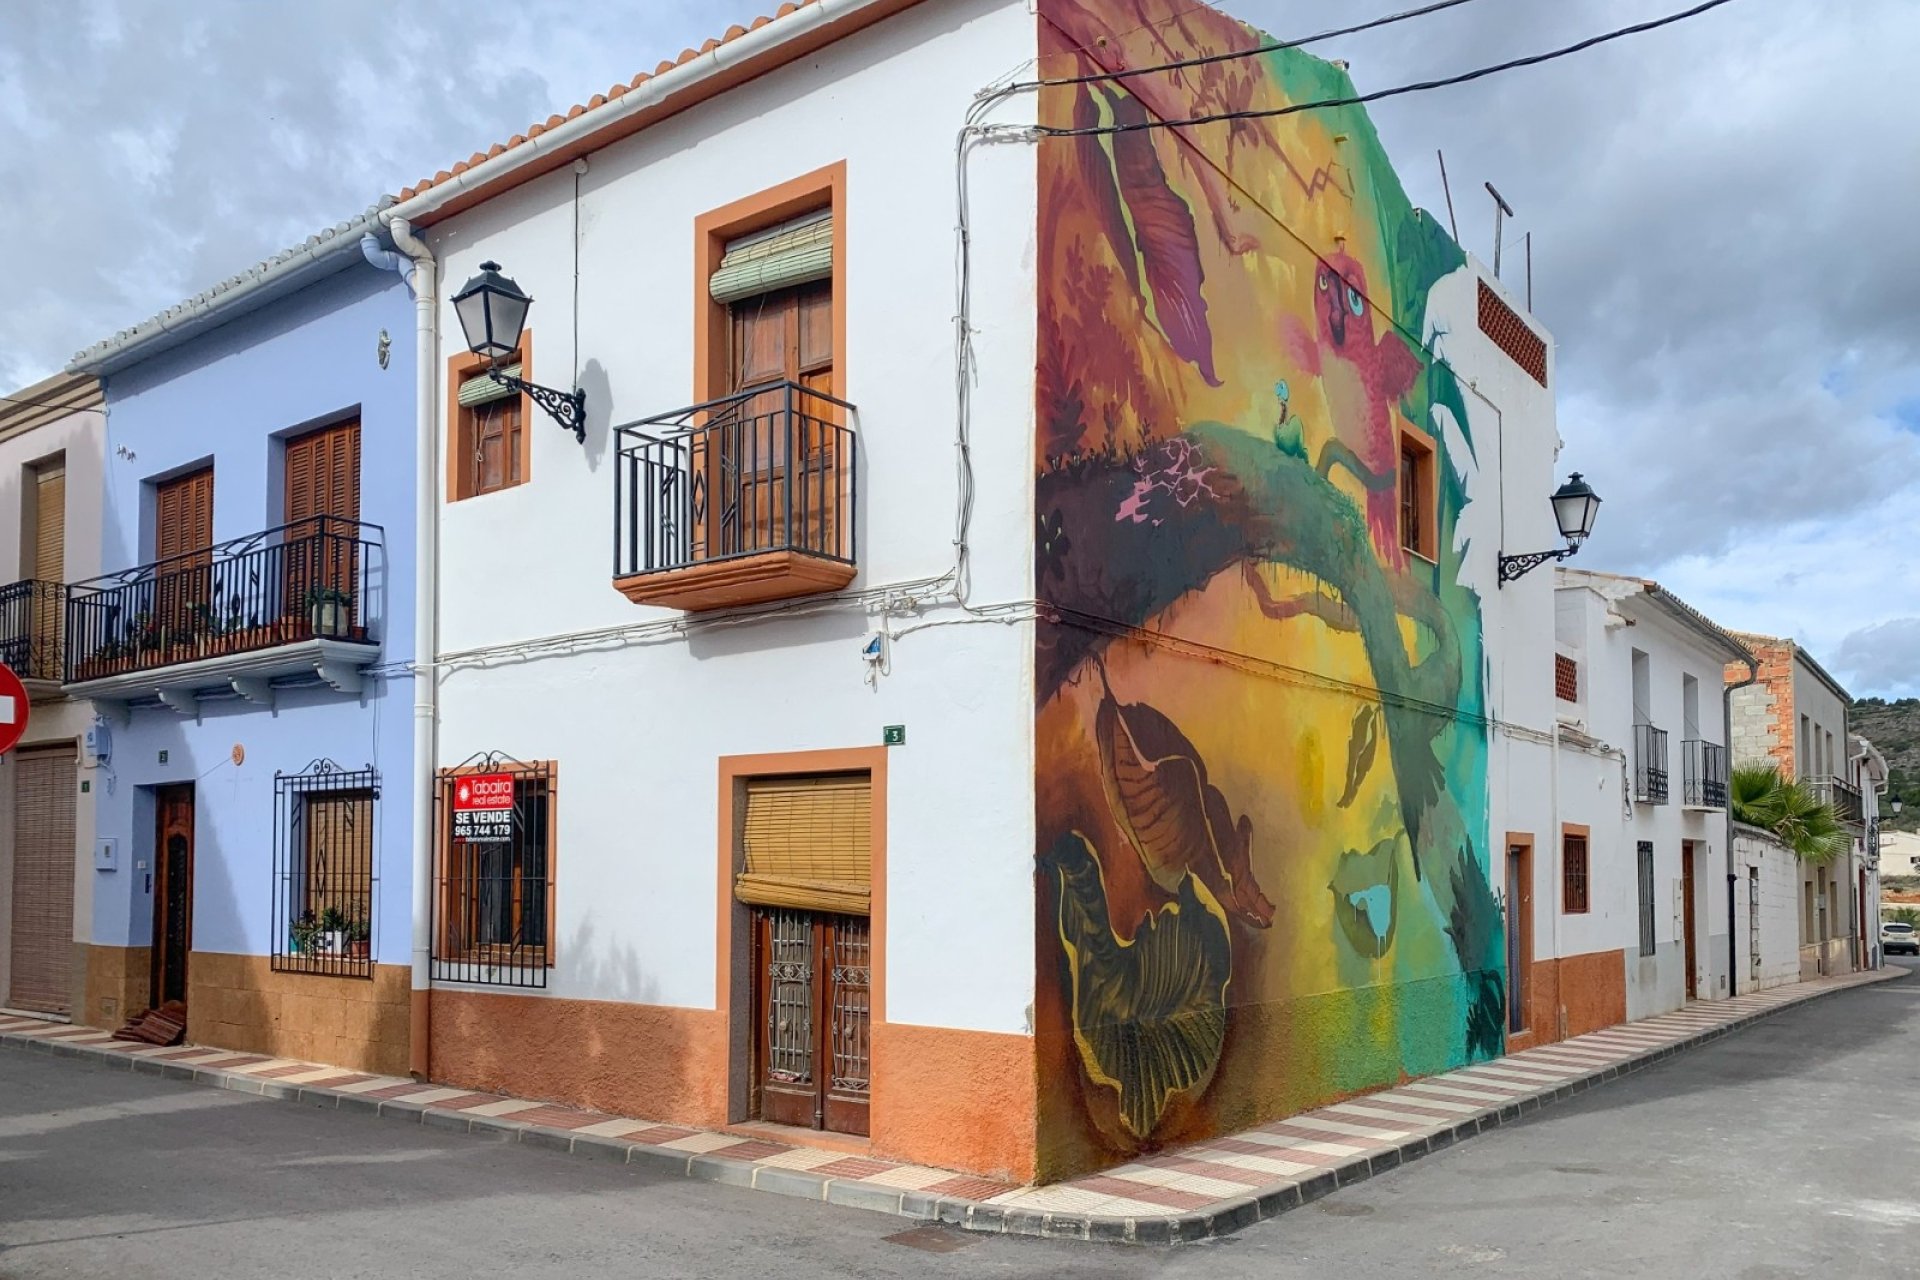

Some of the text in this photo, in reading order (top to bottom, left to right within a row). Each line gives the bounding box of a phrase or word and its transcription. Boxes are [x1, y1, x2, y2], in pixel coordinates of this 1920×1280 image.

[892, 730, 899, 742] 3
[471, 779, 511, 795] Tabaira
[472, 795, 511, 805] real estate
[455, 811, 511, 824] SE VENDE
[455, 824, 511, 836] 965 744 179
